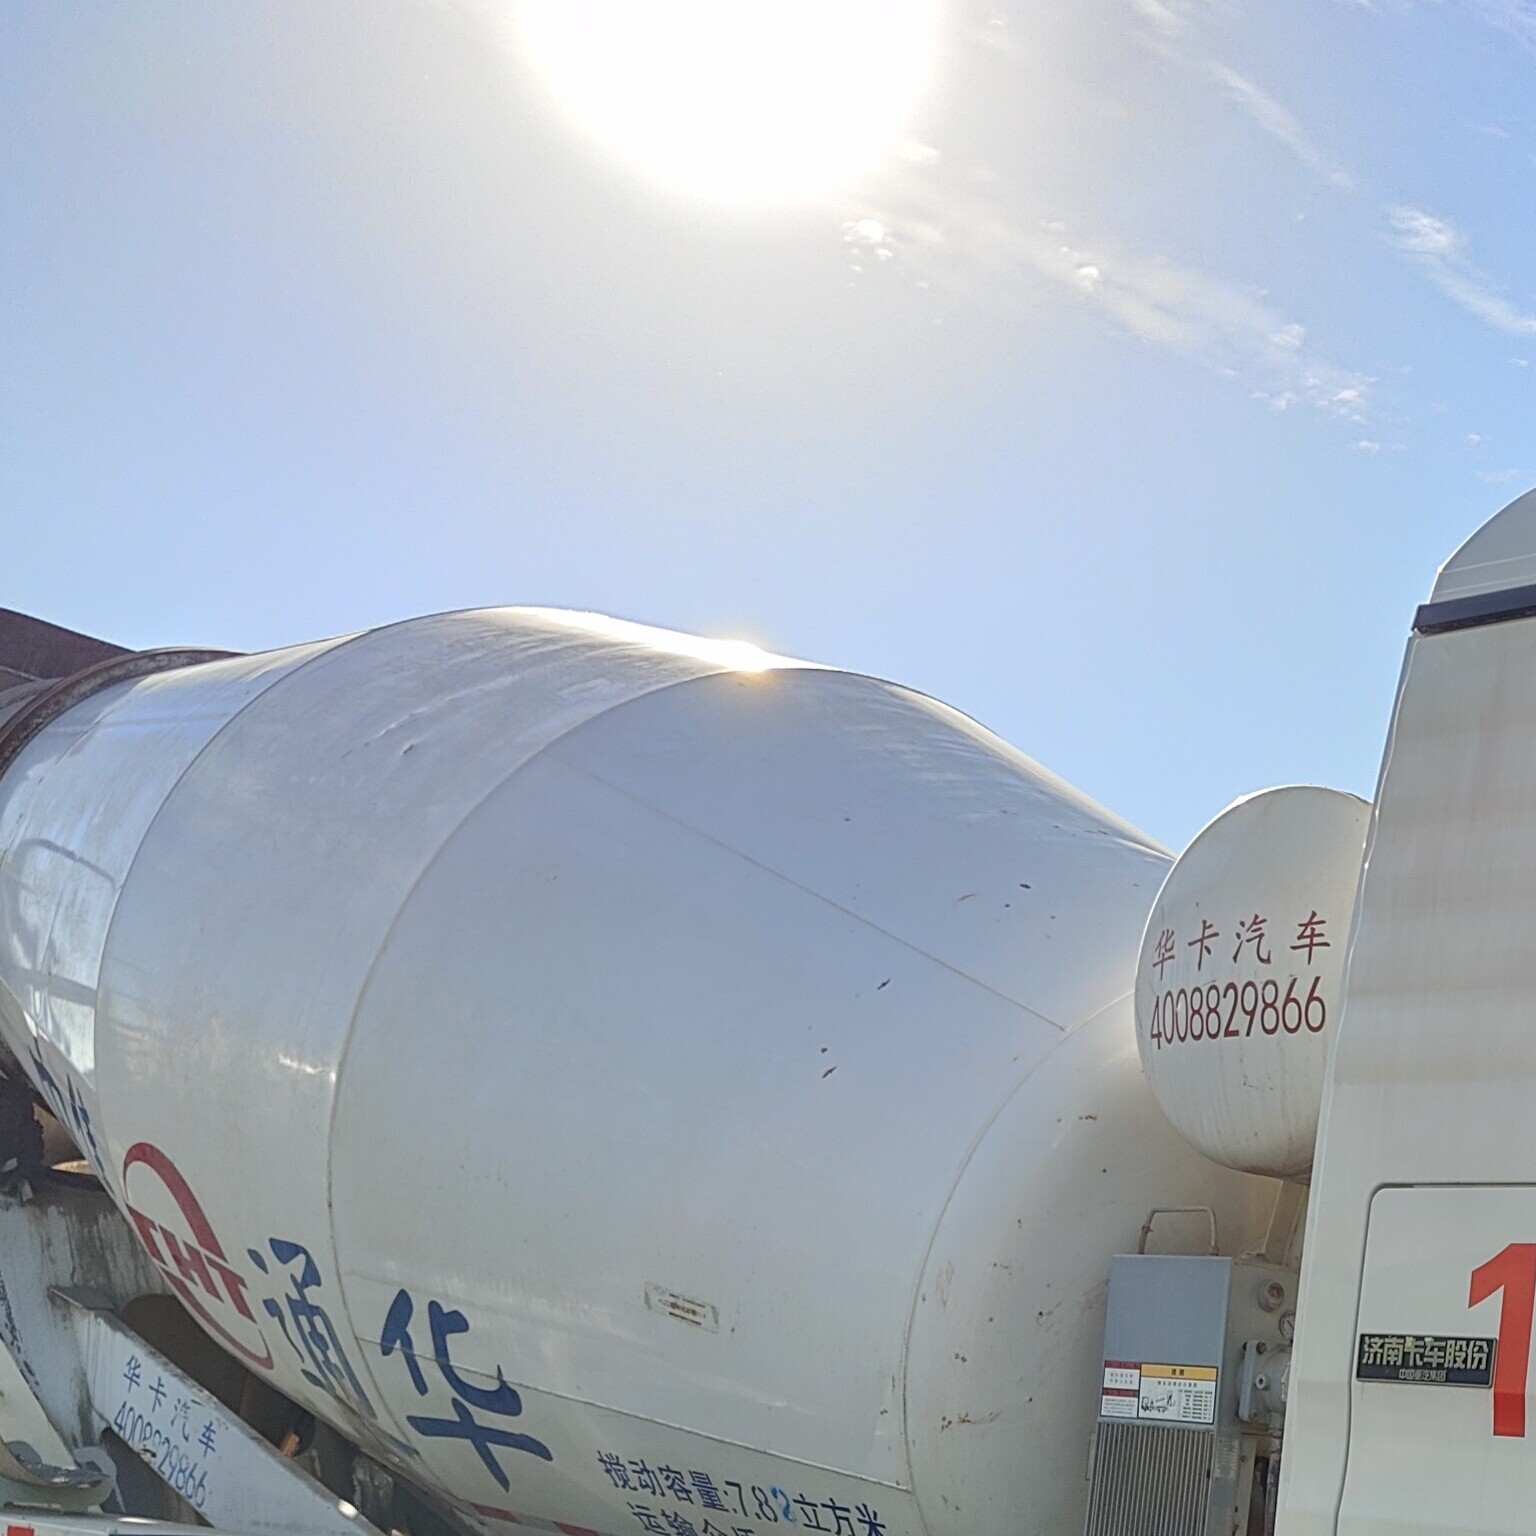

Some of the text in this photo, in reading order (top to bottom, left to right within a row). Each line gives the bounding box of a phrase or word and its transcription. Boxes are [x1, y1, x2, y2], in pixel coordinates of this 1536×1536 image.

[1152, 910, 1331, 981] 华卡汽车
[1150, 976, 1327, 1050] 4008829866
[247, 1236, 553, 1493] 通华
[1362, 1335, 1490, 1370] 济南卡车股份
[123, 1355, 217, 1458] 华卡汽车
